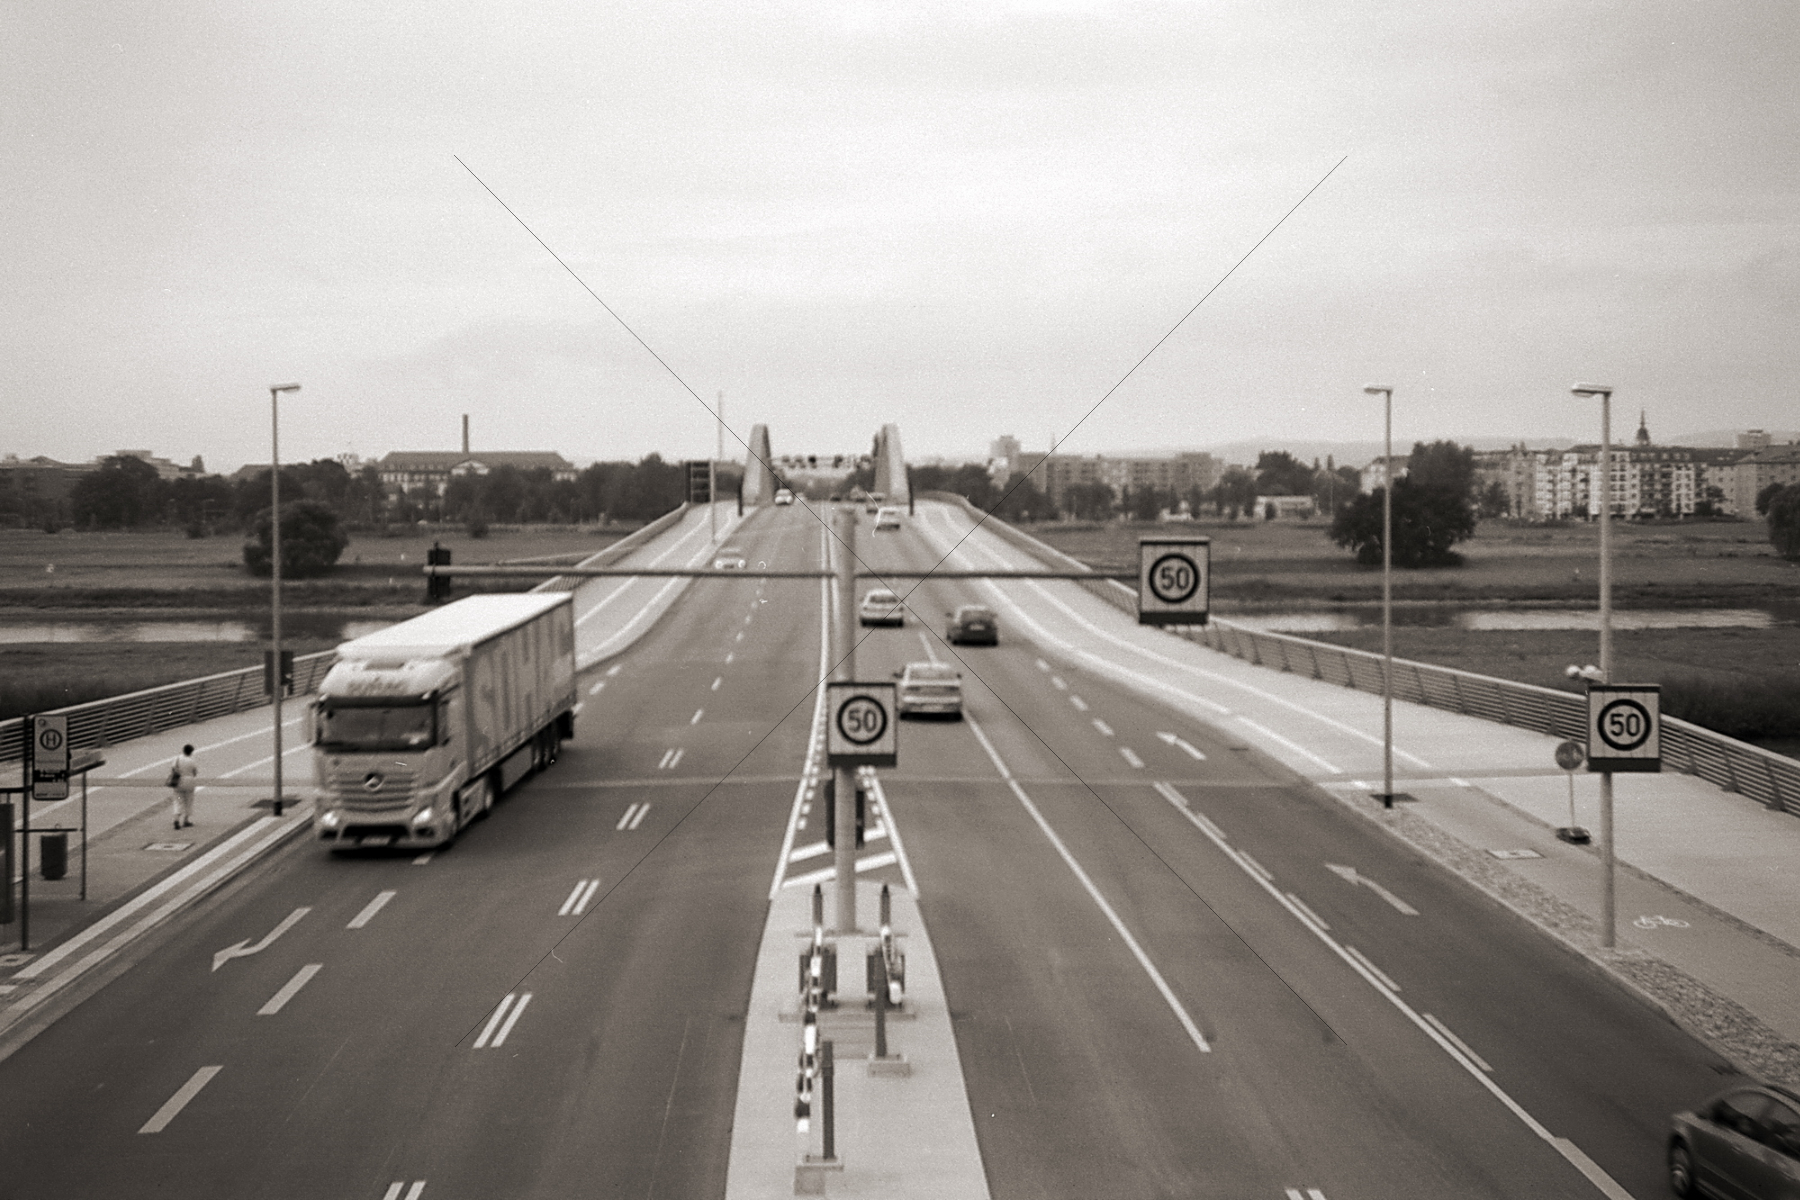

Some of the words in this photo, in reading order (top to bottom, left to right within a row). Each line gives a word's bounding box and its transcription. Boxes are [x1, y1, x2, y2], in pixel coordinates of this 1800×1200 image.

[1161, 566, 1189, 590] 50
[849, 709, 877, 733] 50
[1610, 713, 1640, 737] 50
[45, 733, 57, 747] H
